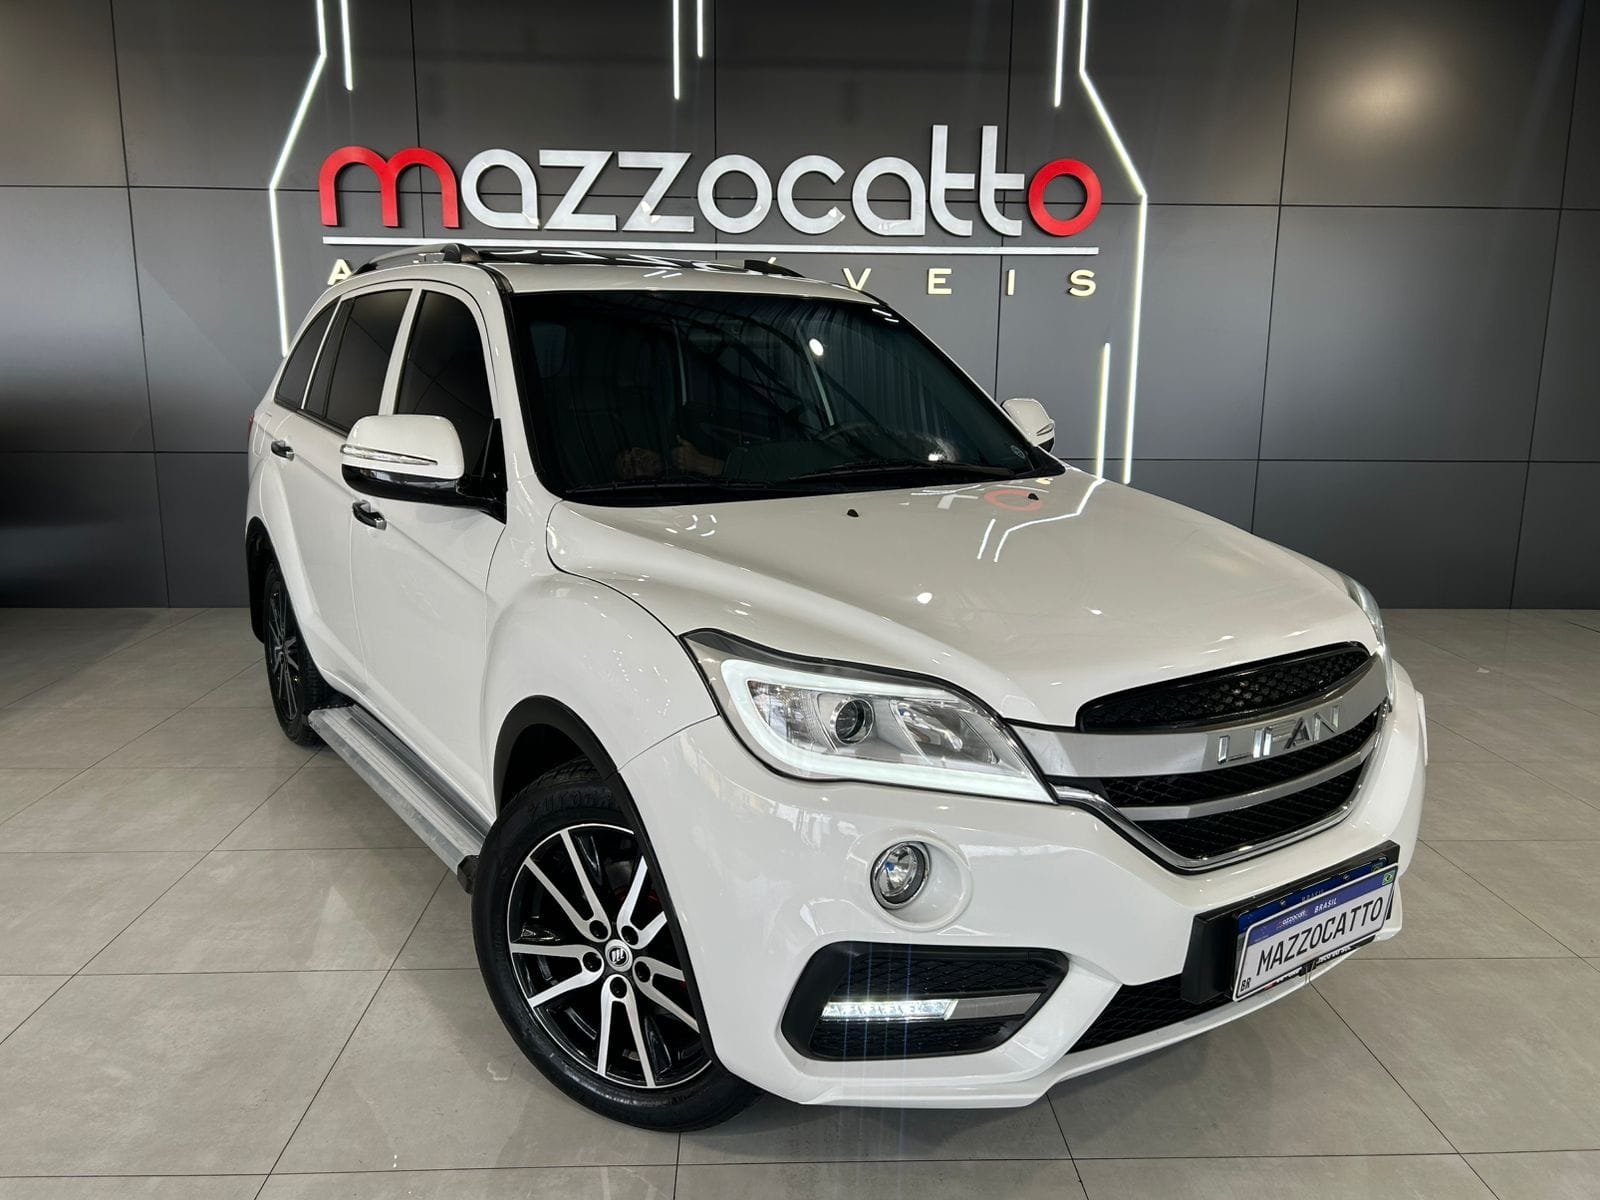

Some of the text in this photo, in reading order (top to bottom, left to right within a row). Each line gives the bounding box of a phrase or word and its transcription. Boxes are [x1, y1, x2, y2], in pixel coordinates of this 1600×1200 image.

[320, 125, 1102, 236] mazzocatto
[1217, 706, 1340, 763] LIFAN
[1256, 897, 1383, 976] MAZZOCATTO
[1314, 898, 1337, 913] BRASIL
